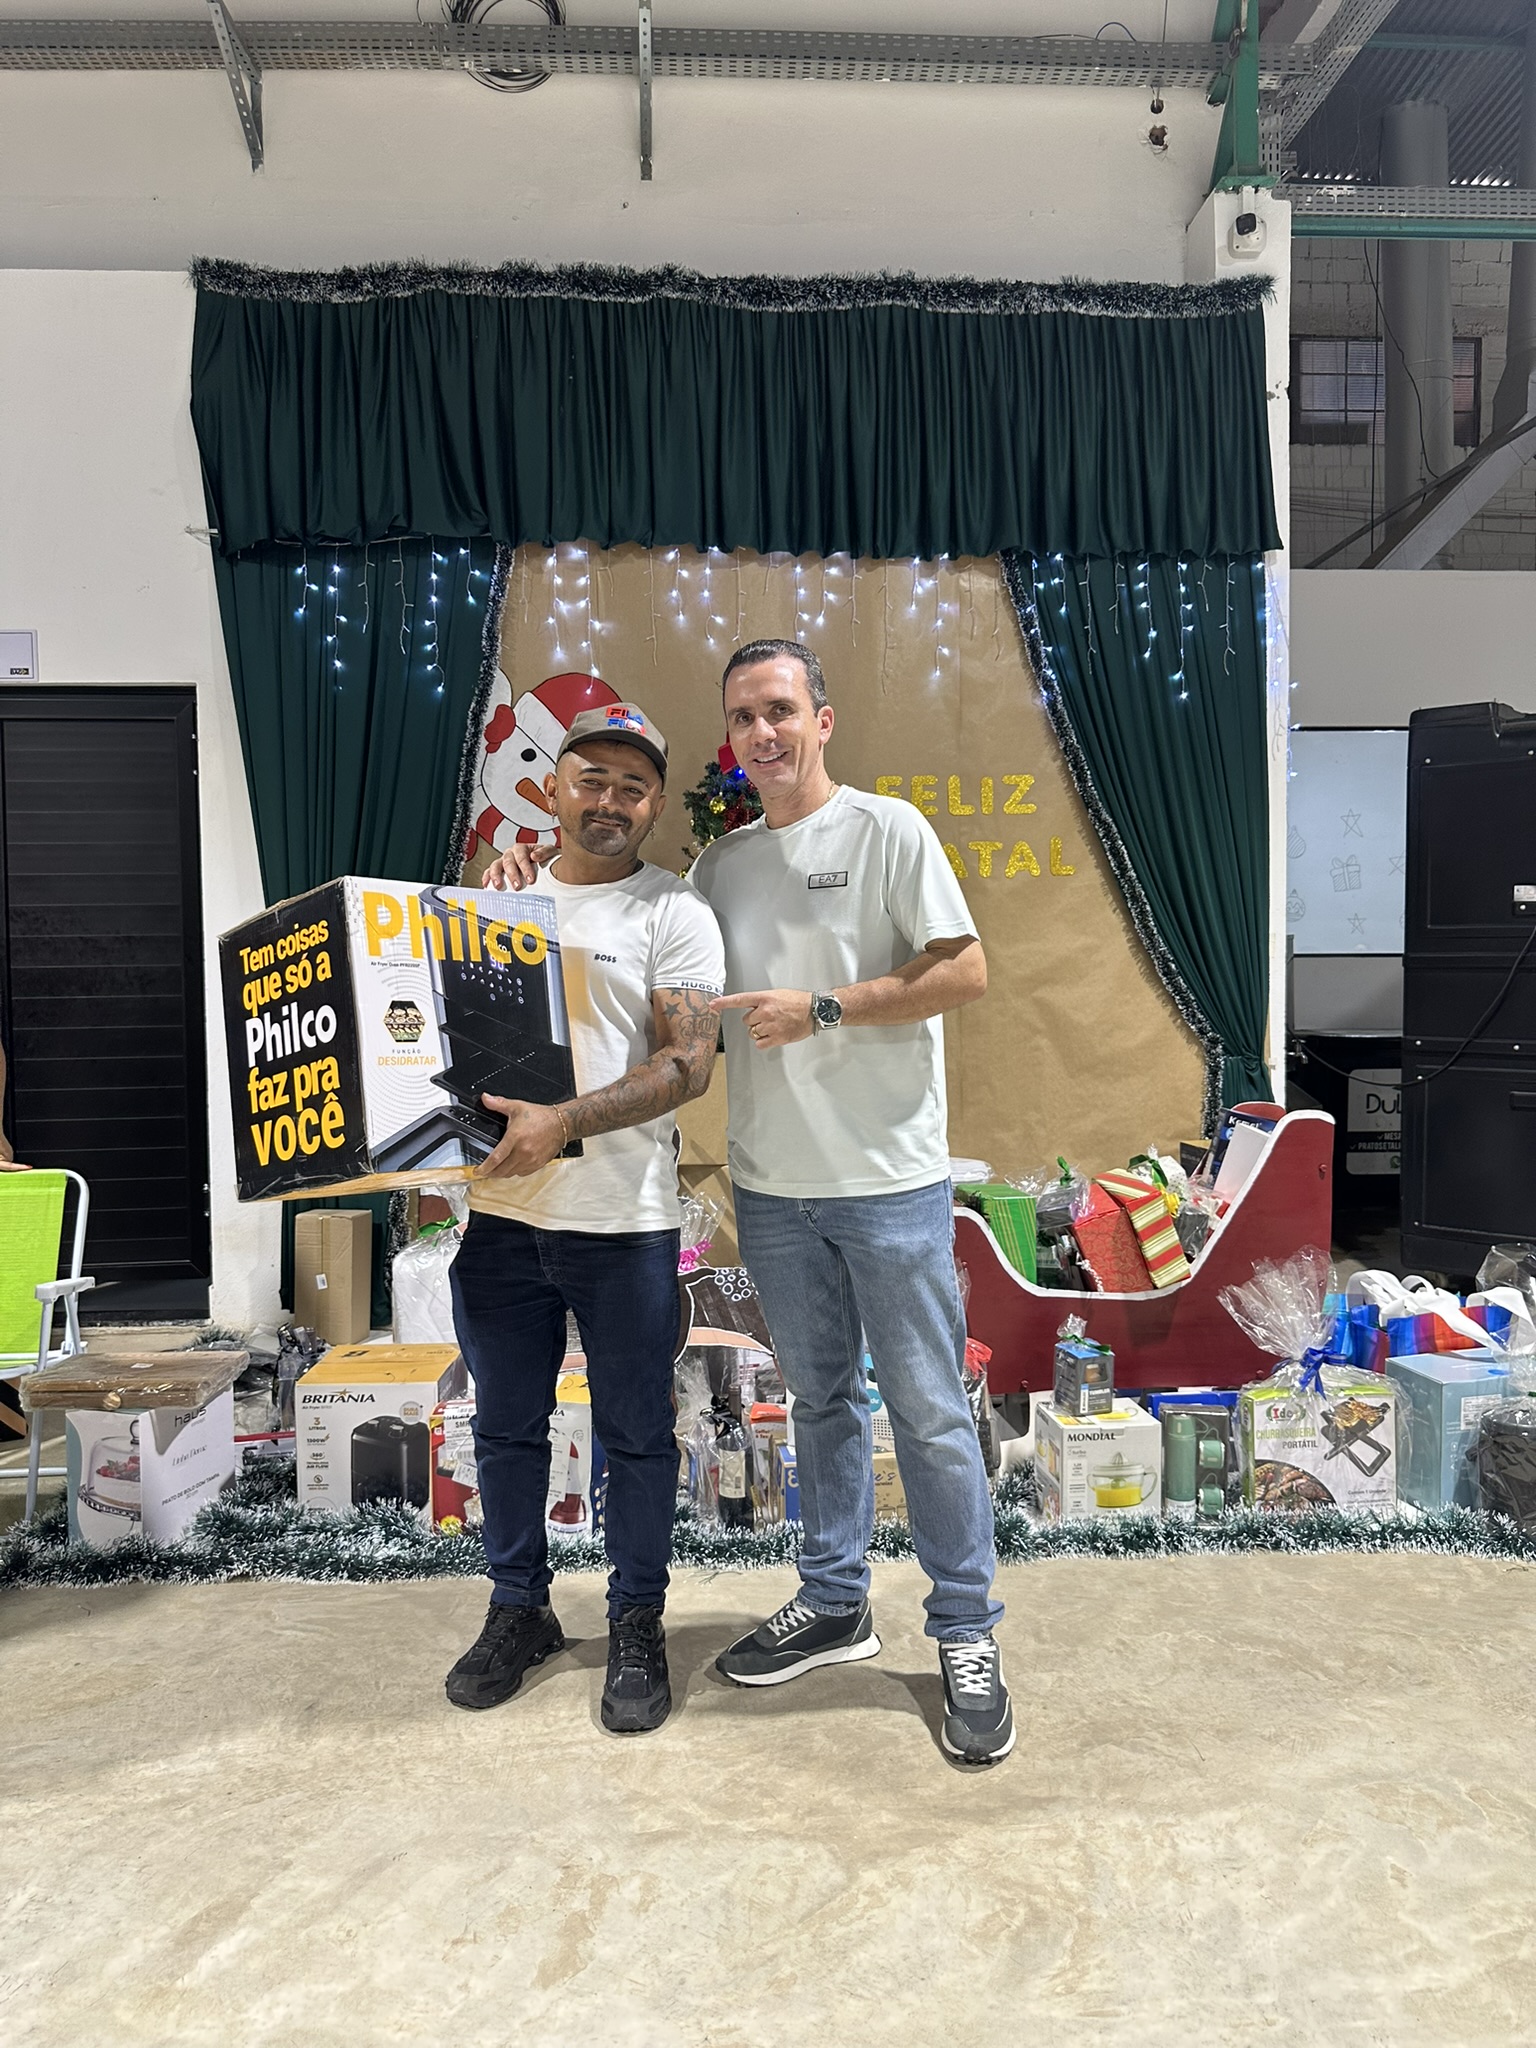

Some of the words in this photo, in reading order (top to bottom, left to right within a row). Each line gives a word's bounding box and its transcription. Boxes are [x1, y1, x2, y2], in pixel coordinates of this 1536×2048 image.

[875, 774, 1038, 816] FELIZ
[943, 836, 1077, 880] ATAL
[818, 874, 838, 884] EA7
[362, 890, 549, 966] Philco
[239, 943, 276, 976] Tem
[275, 917, 329, 961] coisas
[594, 953, 617, 964] BOSS
[242, 974, 283, 1018] que
[285, 953, 313, 995] só
[316, 950, 332, 984] a
[681, 981, 713, 990] HUGO
[245, 1003, 337, 1068] Philco
[377, 1055, 438, 1067] DESIDRATAR
[247, 1067, 290, 1114] faz
[293, 1055, 341, 1108] pra
[174, 1405, 207, 1428] haus
[313, 1416, 321, 1425] 3
[1067, 1431, 1117, 1442] MONDIAL
[1282, 1439, 1318, 1449] PORTÁTIL
